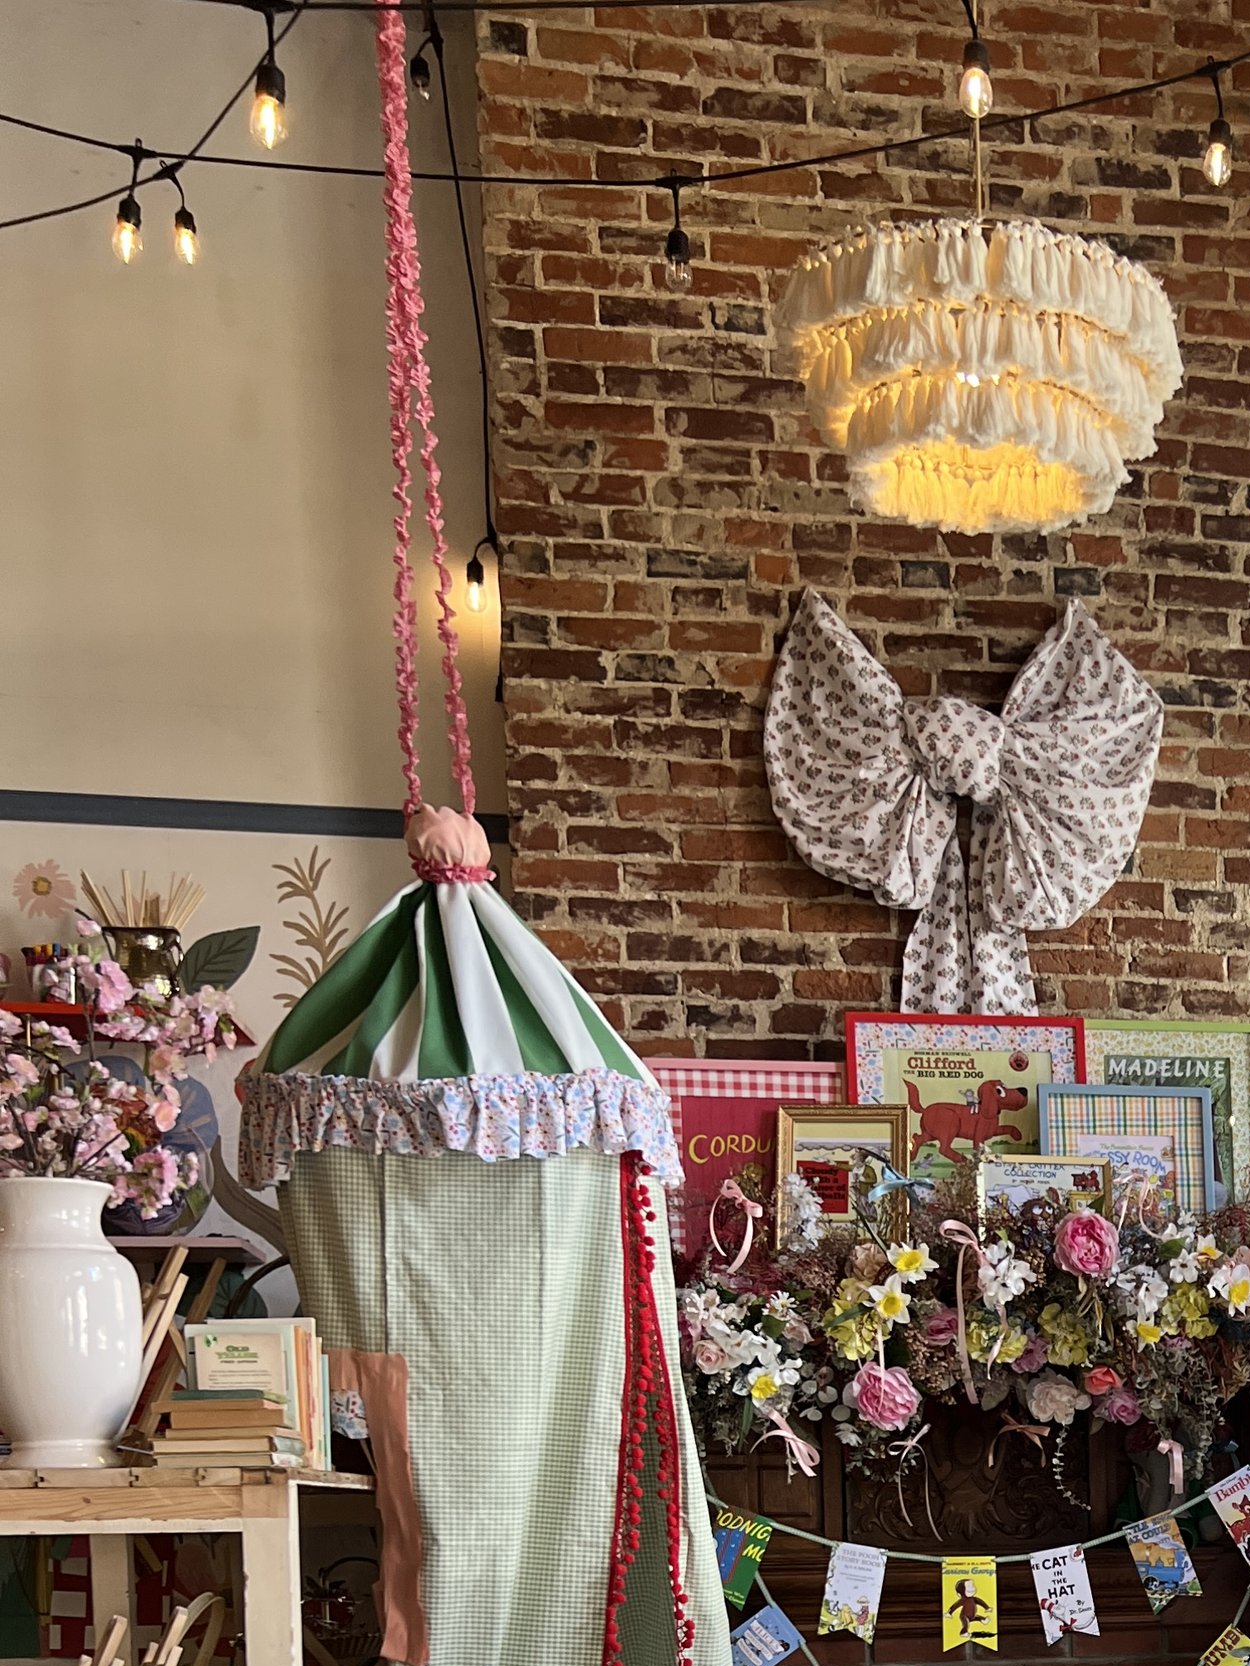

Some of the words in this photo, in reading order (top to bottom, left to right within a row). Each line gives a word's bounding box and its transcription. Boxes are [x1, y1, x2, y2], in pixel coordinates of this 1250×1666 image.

[907, 1056, 977, 1071] Clifford
[1108, 1058, 1226, 1079] MADELINE
[917, 1069, 937, 1079] BIG
[938, 1070, 962, 1080] RED
[963, 1071, 985, 1080] DOG
[688, 1132, 772, 1165] CORDU
[1042, 1555, 1068, 1570] CAT
[971, 1567, 996, 1577] Georg
[1052, 1577, 1068, 1585] THE
[1048, 1584, 1076, 1600] HAT
[1076, 1599, 1086, 1607] By
